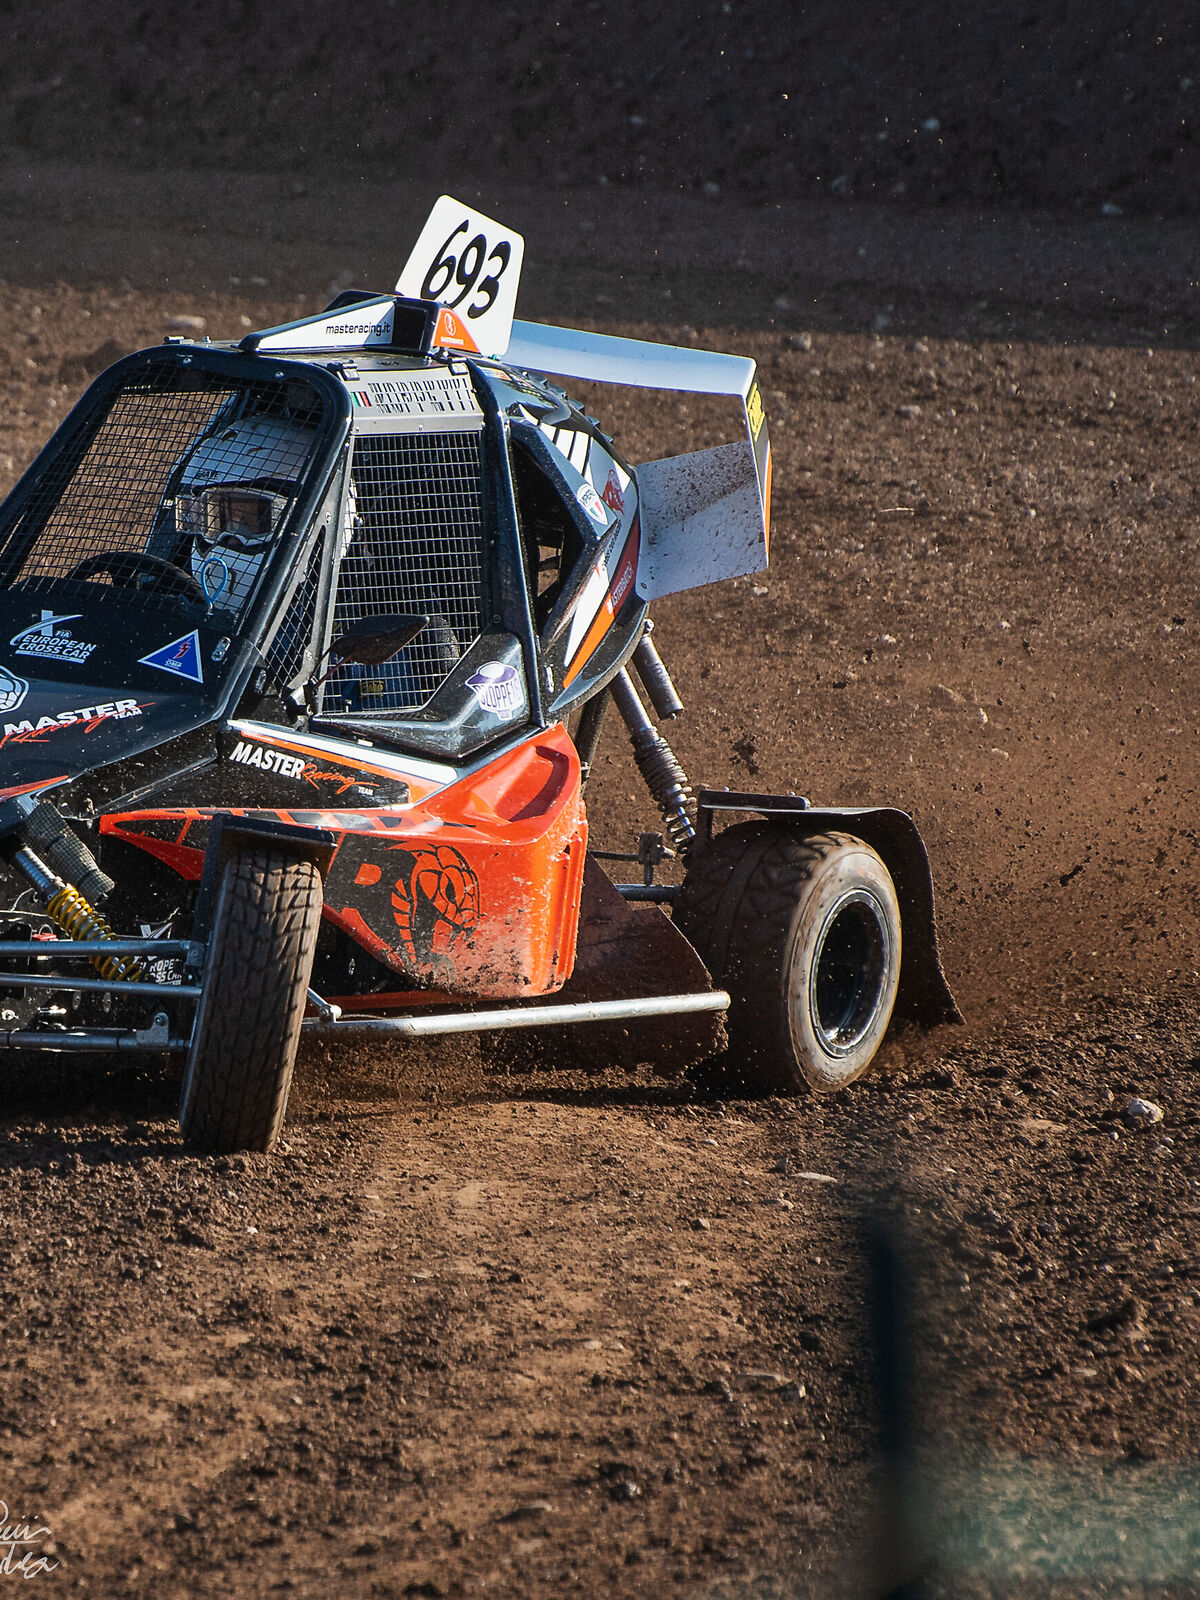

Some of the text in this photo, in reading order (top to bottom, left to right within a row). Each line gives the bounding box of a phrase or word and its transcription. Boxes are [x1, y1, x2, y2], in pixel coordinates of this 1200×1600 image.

[420, 219, 511, 320] 693
[325, 322, 391, 336] masteracing.it
[18, 642, 63, 655] CROSS
[61, 648, 91, 660] CAR
[22, 634, 97, 652] EUROPEAN
[3, 698, 138, 736] MASTER
[112, 708, 143, 720] TEAM
[229, 741, 380, 796] MASTER Racing TEAM
